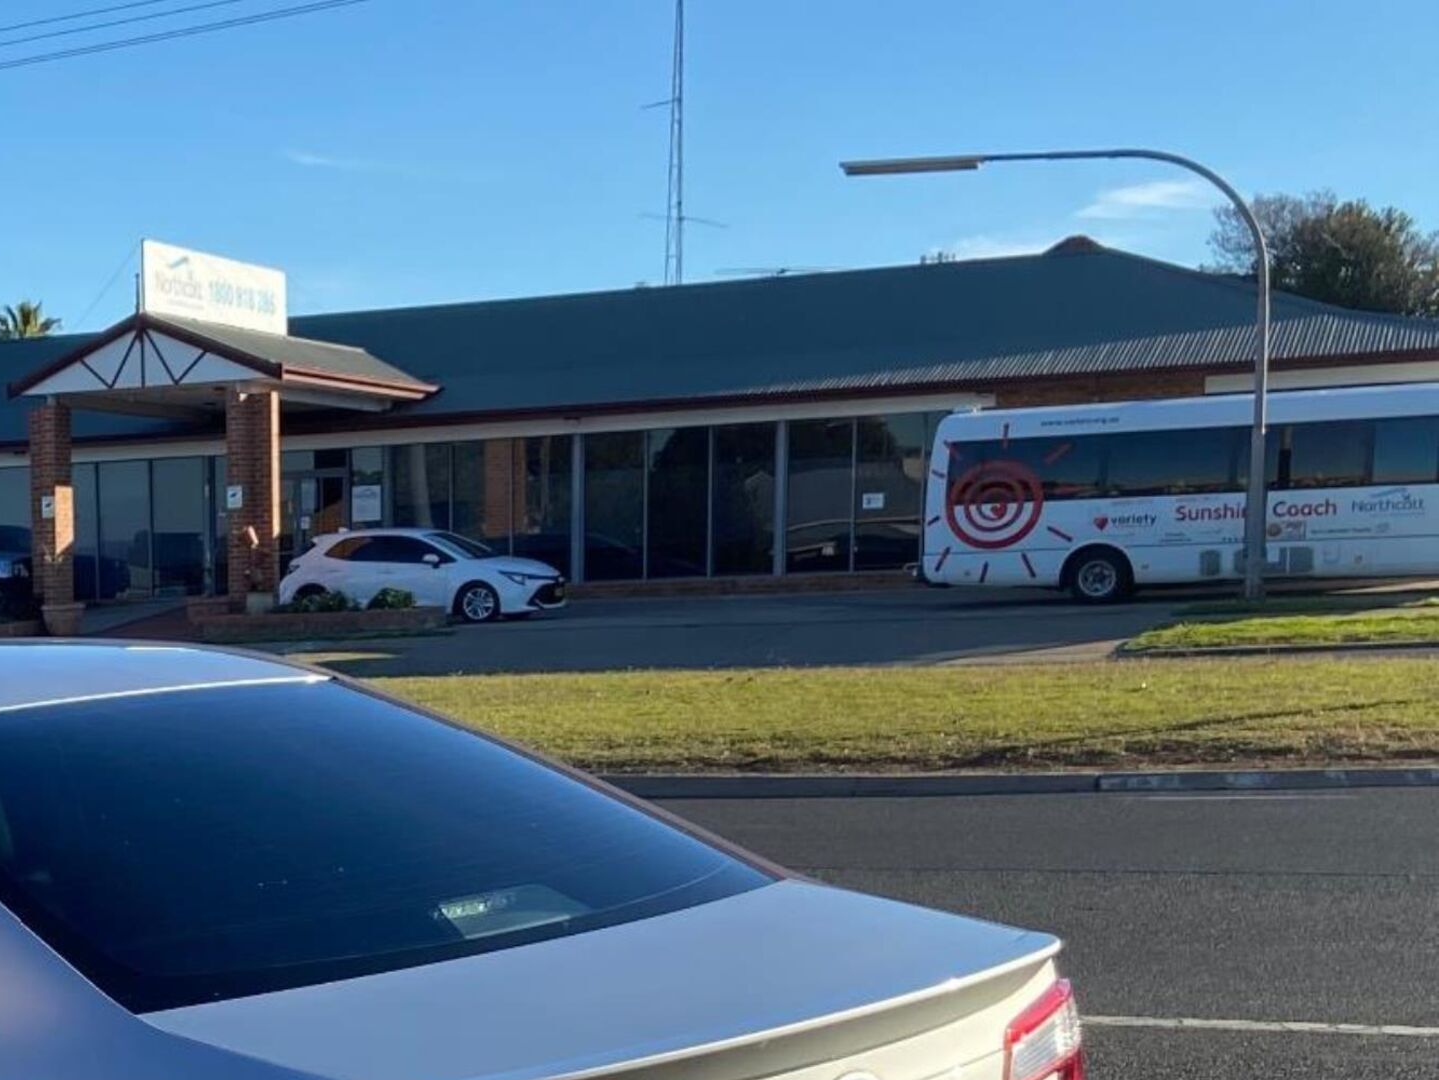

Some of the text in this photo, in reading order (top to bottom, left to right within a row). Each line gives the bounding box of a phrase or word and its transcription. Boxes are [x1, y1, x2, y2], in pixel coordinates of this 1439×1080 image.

[1272, 498, 1337, 518] Coach
[1351, 496, 1425, 513] Northcott
[1111, 504, 1157, 526] variety
